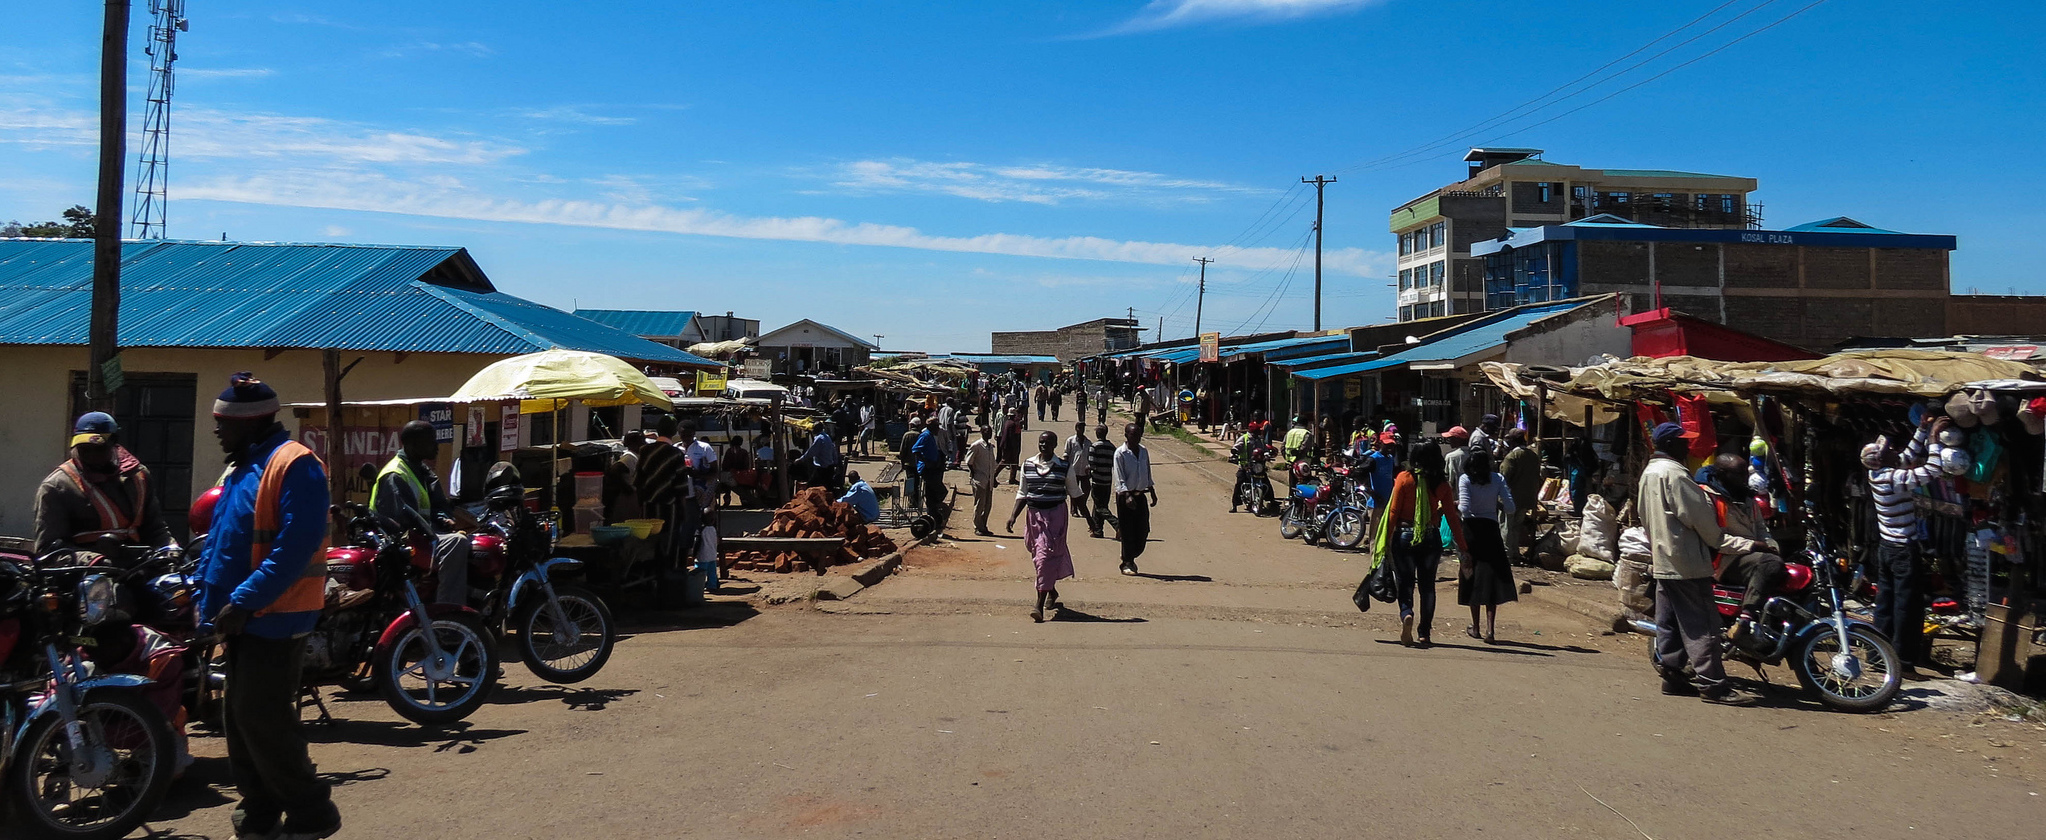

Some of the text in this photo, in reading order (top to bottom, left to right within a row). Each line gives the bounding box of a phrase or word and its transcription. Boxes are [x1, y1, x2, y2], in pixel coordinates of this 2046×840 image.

[1741, 233, 1793, 244] KOSAL PLAZA
[430, 409, 452, 422] STAR
[435, 428, 454, 440] HERE
